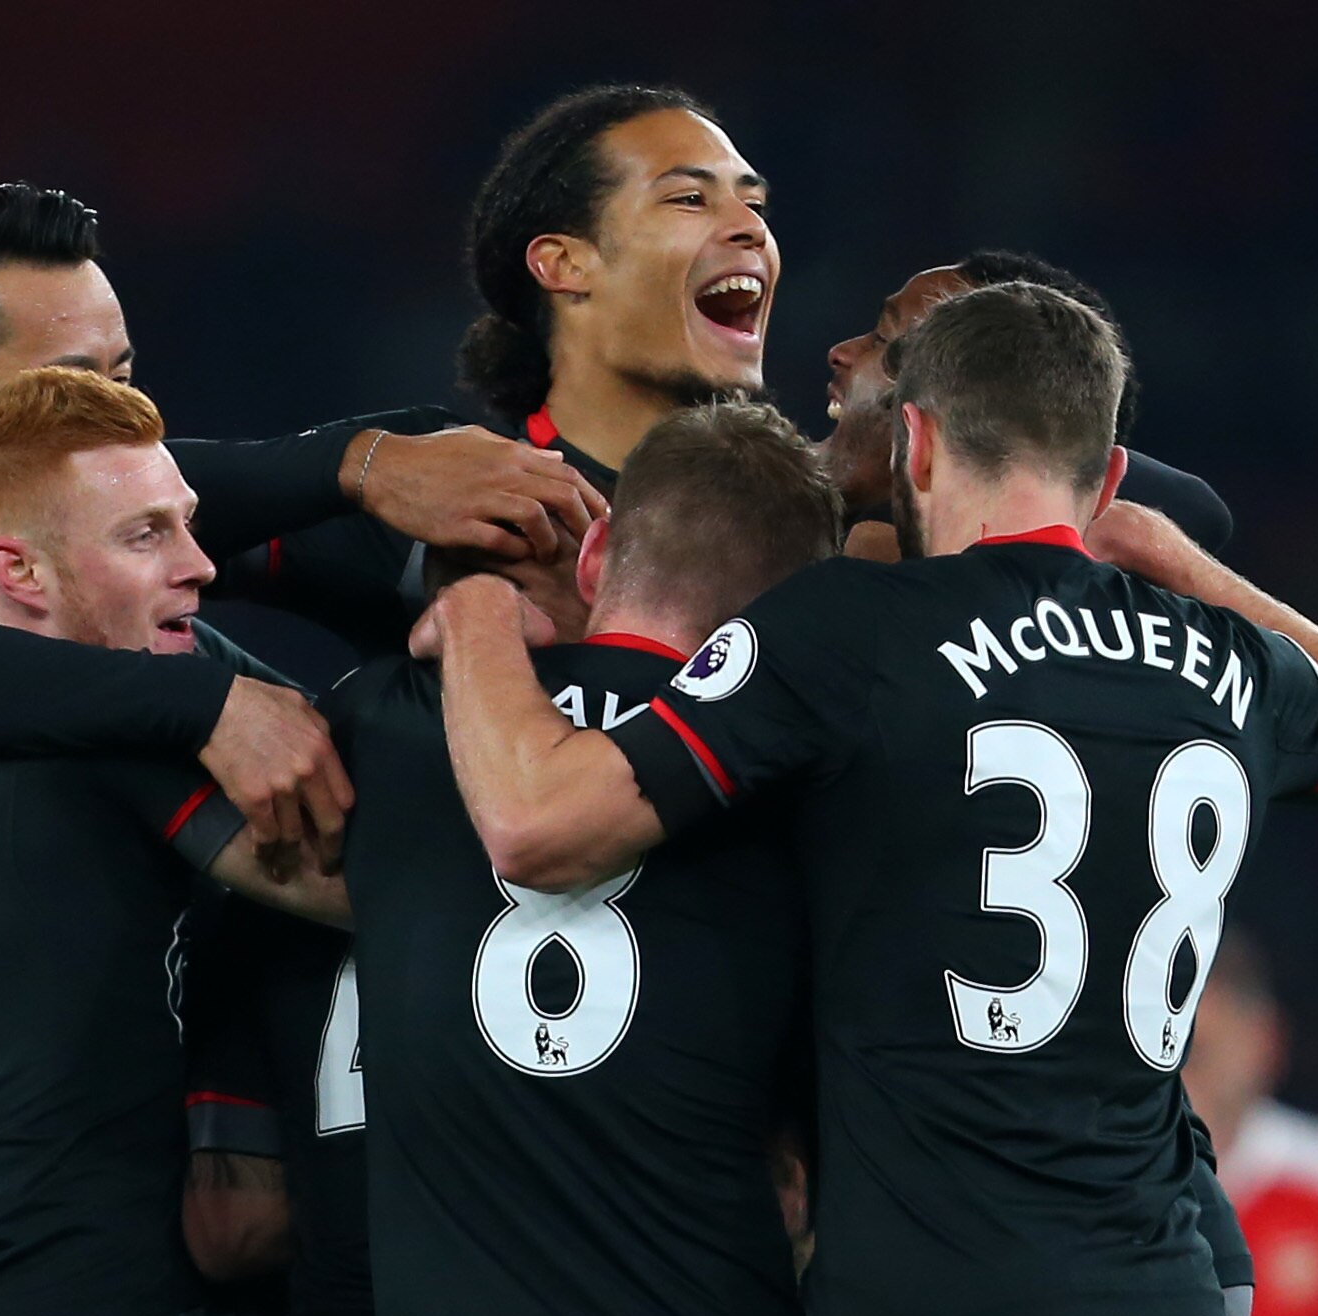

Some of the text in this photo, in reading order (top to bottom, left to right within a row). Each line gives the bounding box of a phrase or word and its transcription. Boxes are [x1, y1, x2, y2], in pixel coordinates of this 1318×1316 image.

[937, 596, 1253, 730] McQUEEN
[471, 853, 641, 1077] 8
[943, 720, 1250, 1073] 38
